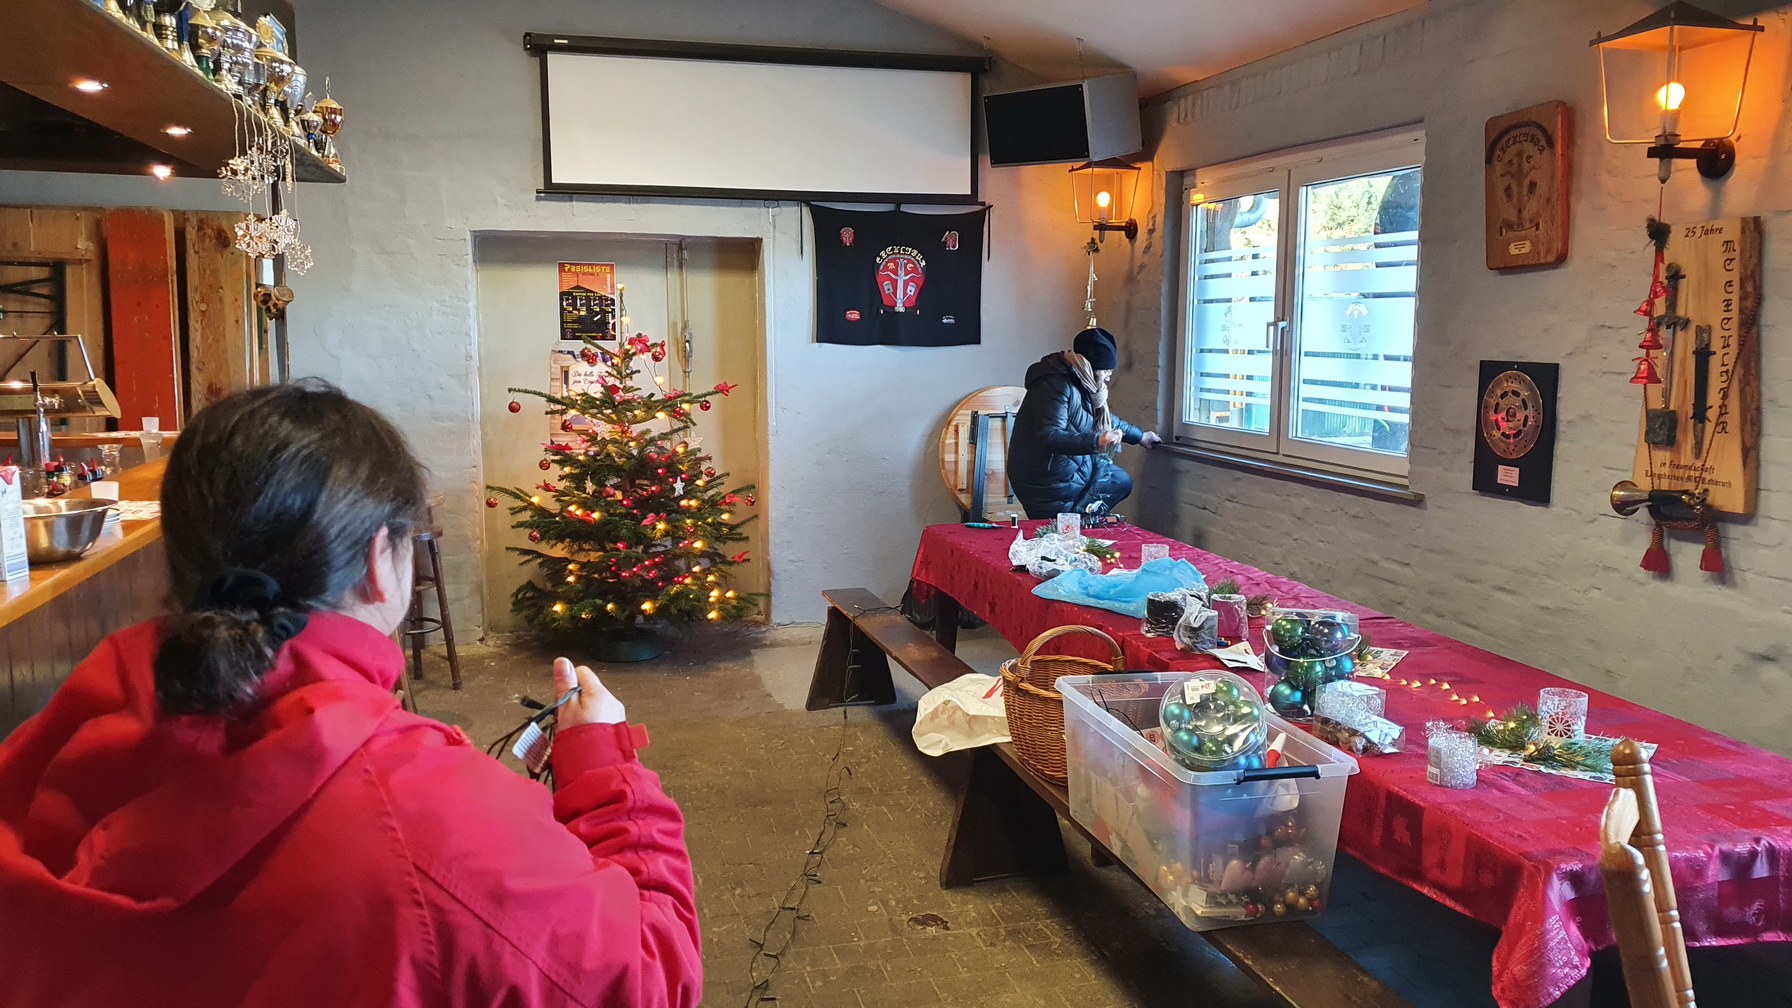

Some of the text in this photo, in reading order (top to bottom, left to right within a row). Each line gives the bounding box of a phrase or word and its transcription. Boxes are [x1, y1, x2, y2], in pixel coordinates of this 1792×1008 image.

[1684, 224, 1724, 239] 25 Jahre
[564, 264, 611, 273] PREISLISTE
[1668, 460, 1715, 476] Freundscaft
